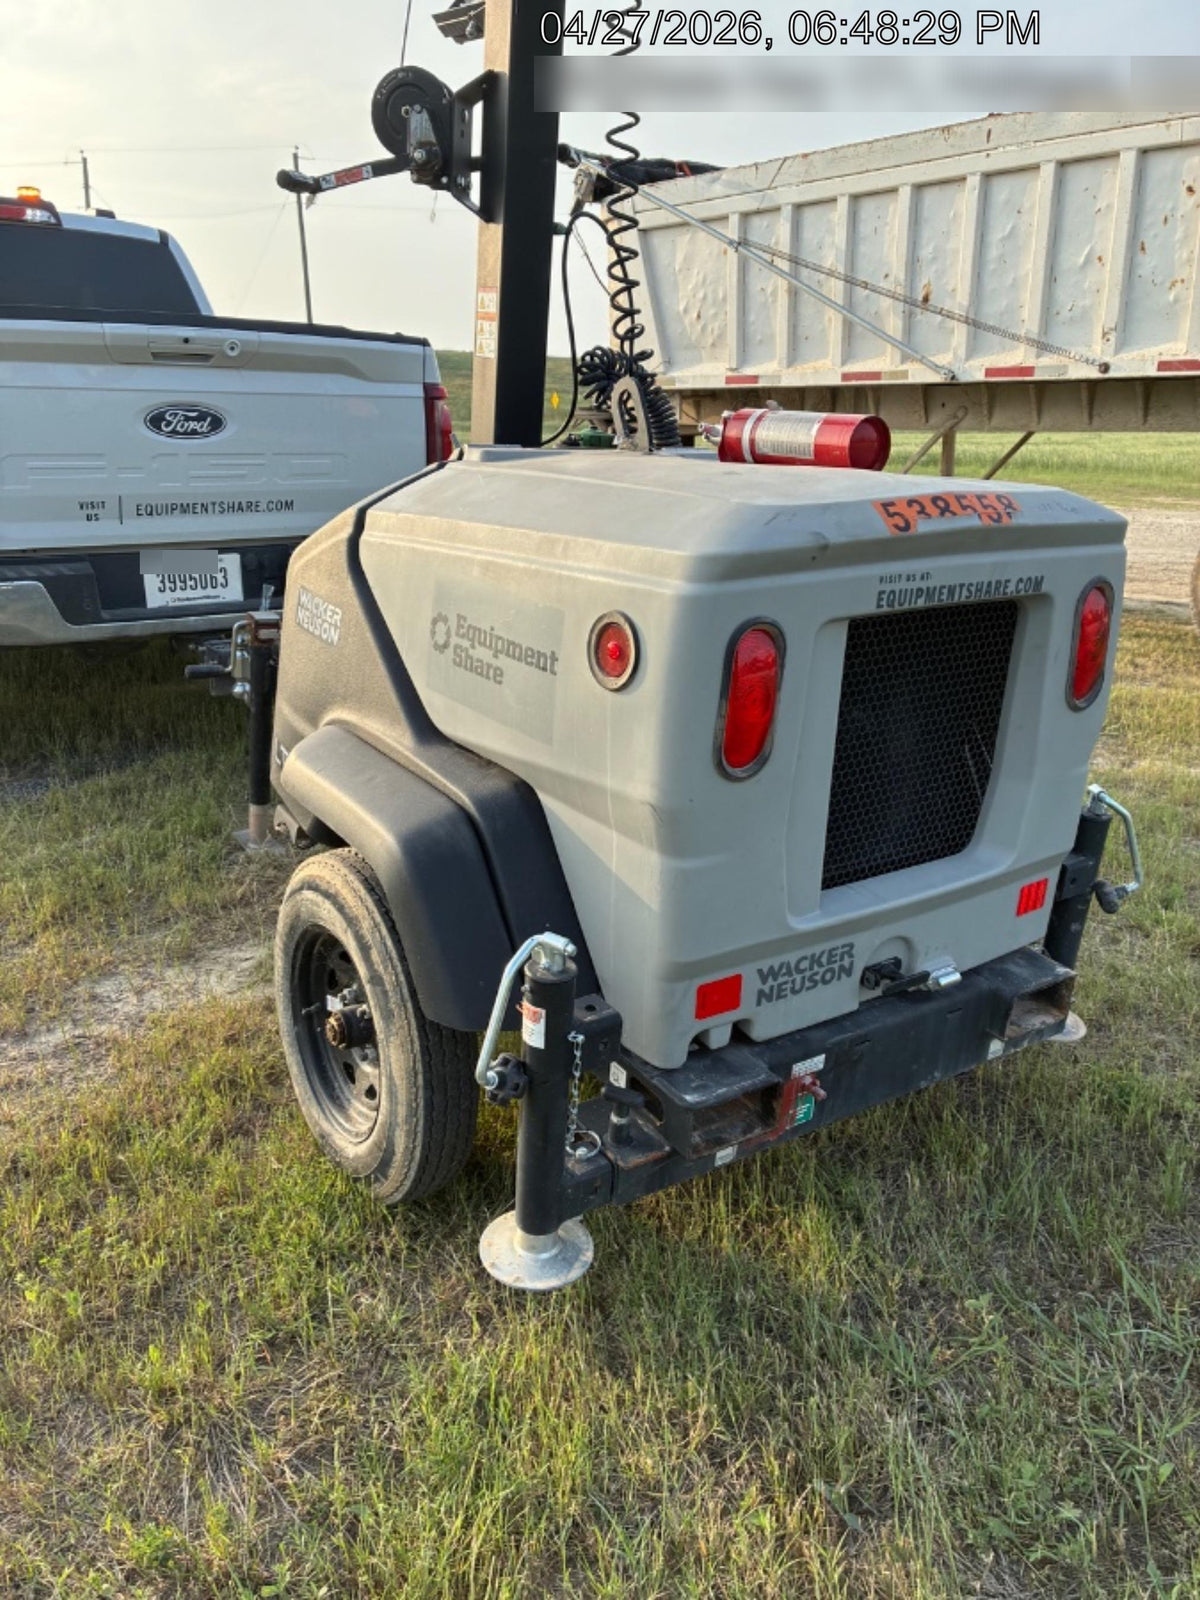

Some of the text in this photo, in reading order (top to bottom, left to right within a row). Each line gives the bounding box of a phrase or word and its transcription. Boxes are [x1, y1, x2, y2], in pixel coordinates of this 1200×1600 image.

[161, 410, 212, 432] Ford
[78, 501, 106, 511] VISIT
[86, 512, 100, 522] US
[136, 500, 294, 517] EQUIPMENTSHARE.COM
[876, 575, 1045, 609] EQUIPMENTSHARE.COM
[879, 573, 902, 584] VISIT
[455, 613, 559, 676] Equipment
[452, 643, 504, 685] Share
[756, 942, 855, 986] WACKER
[755, 959, 854, 1007] NEUSON
